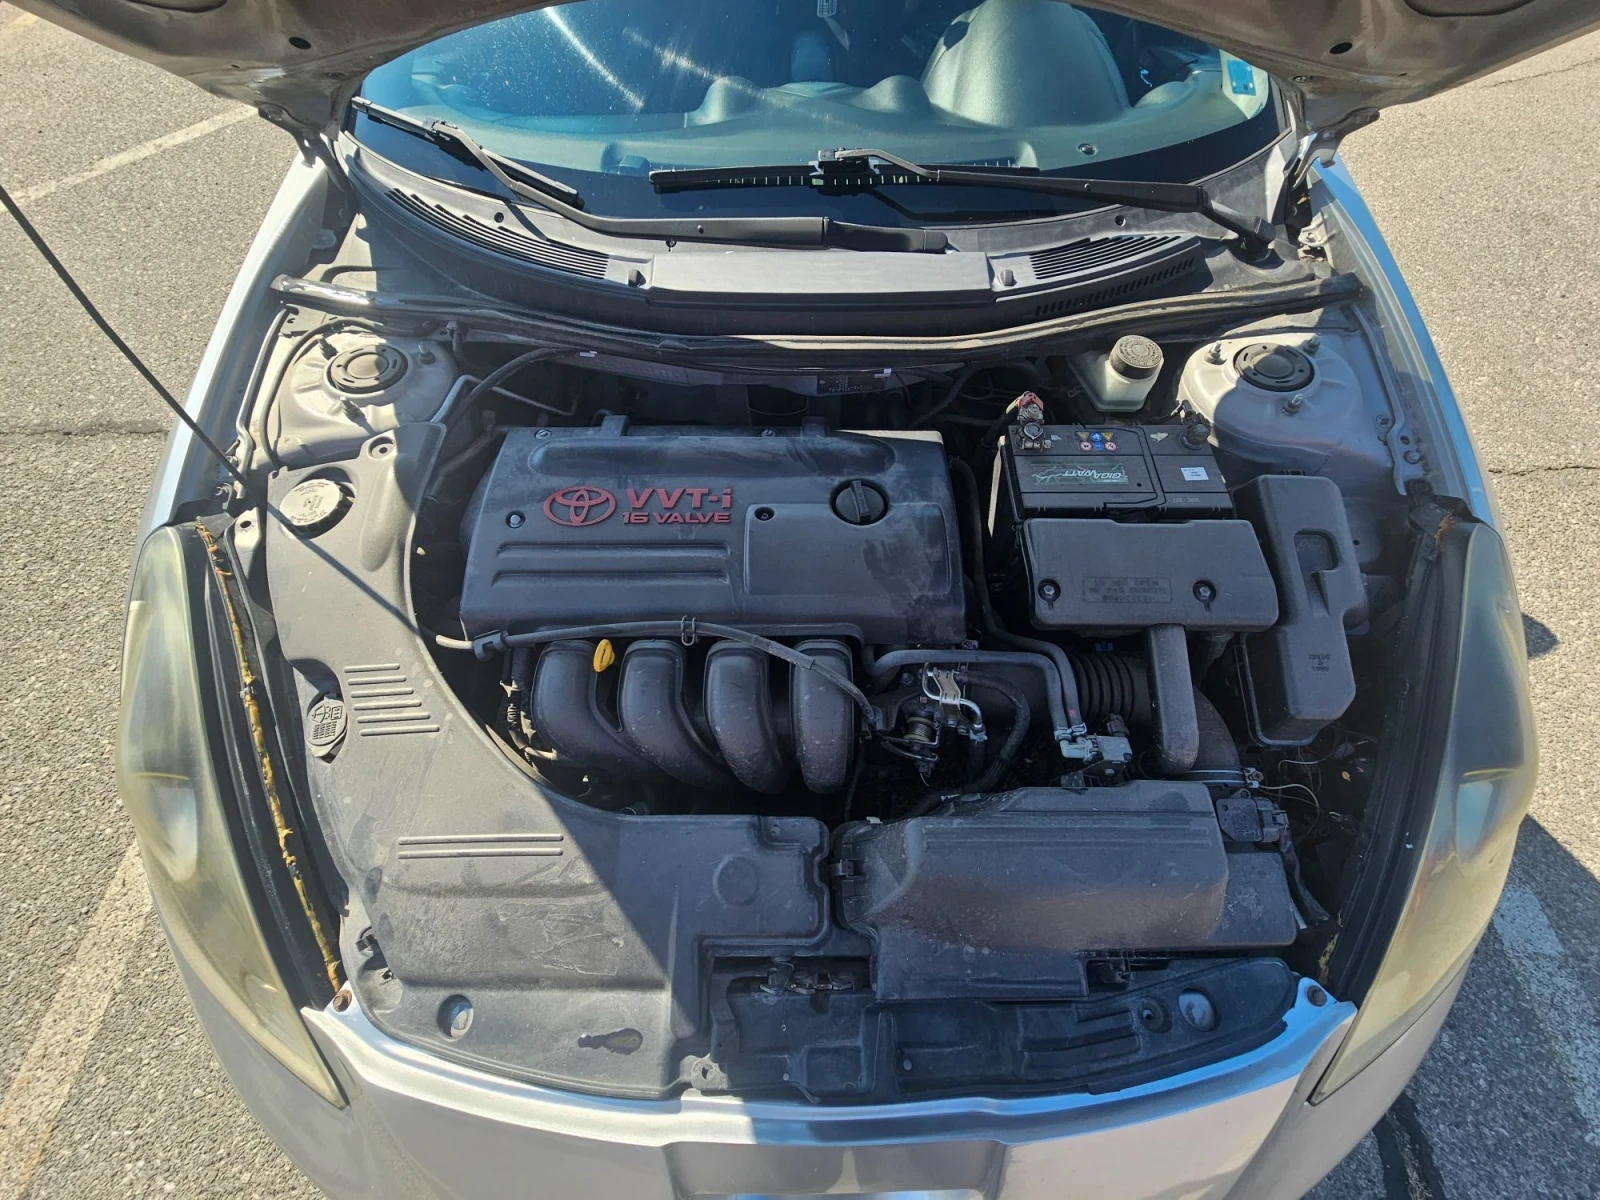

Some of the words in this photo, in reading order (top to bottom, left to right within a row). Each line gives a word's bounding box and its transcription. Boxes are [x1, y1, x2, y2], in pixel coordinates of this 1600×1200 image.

[1062, 469, 1122, 479] GIGAWATT
[627, 488, 732, 509] VVT-i
[623, 512, 649, 524] 16
[654, 512, 731, 524] VALVE
